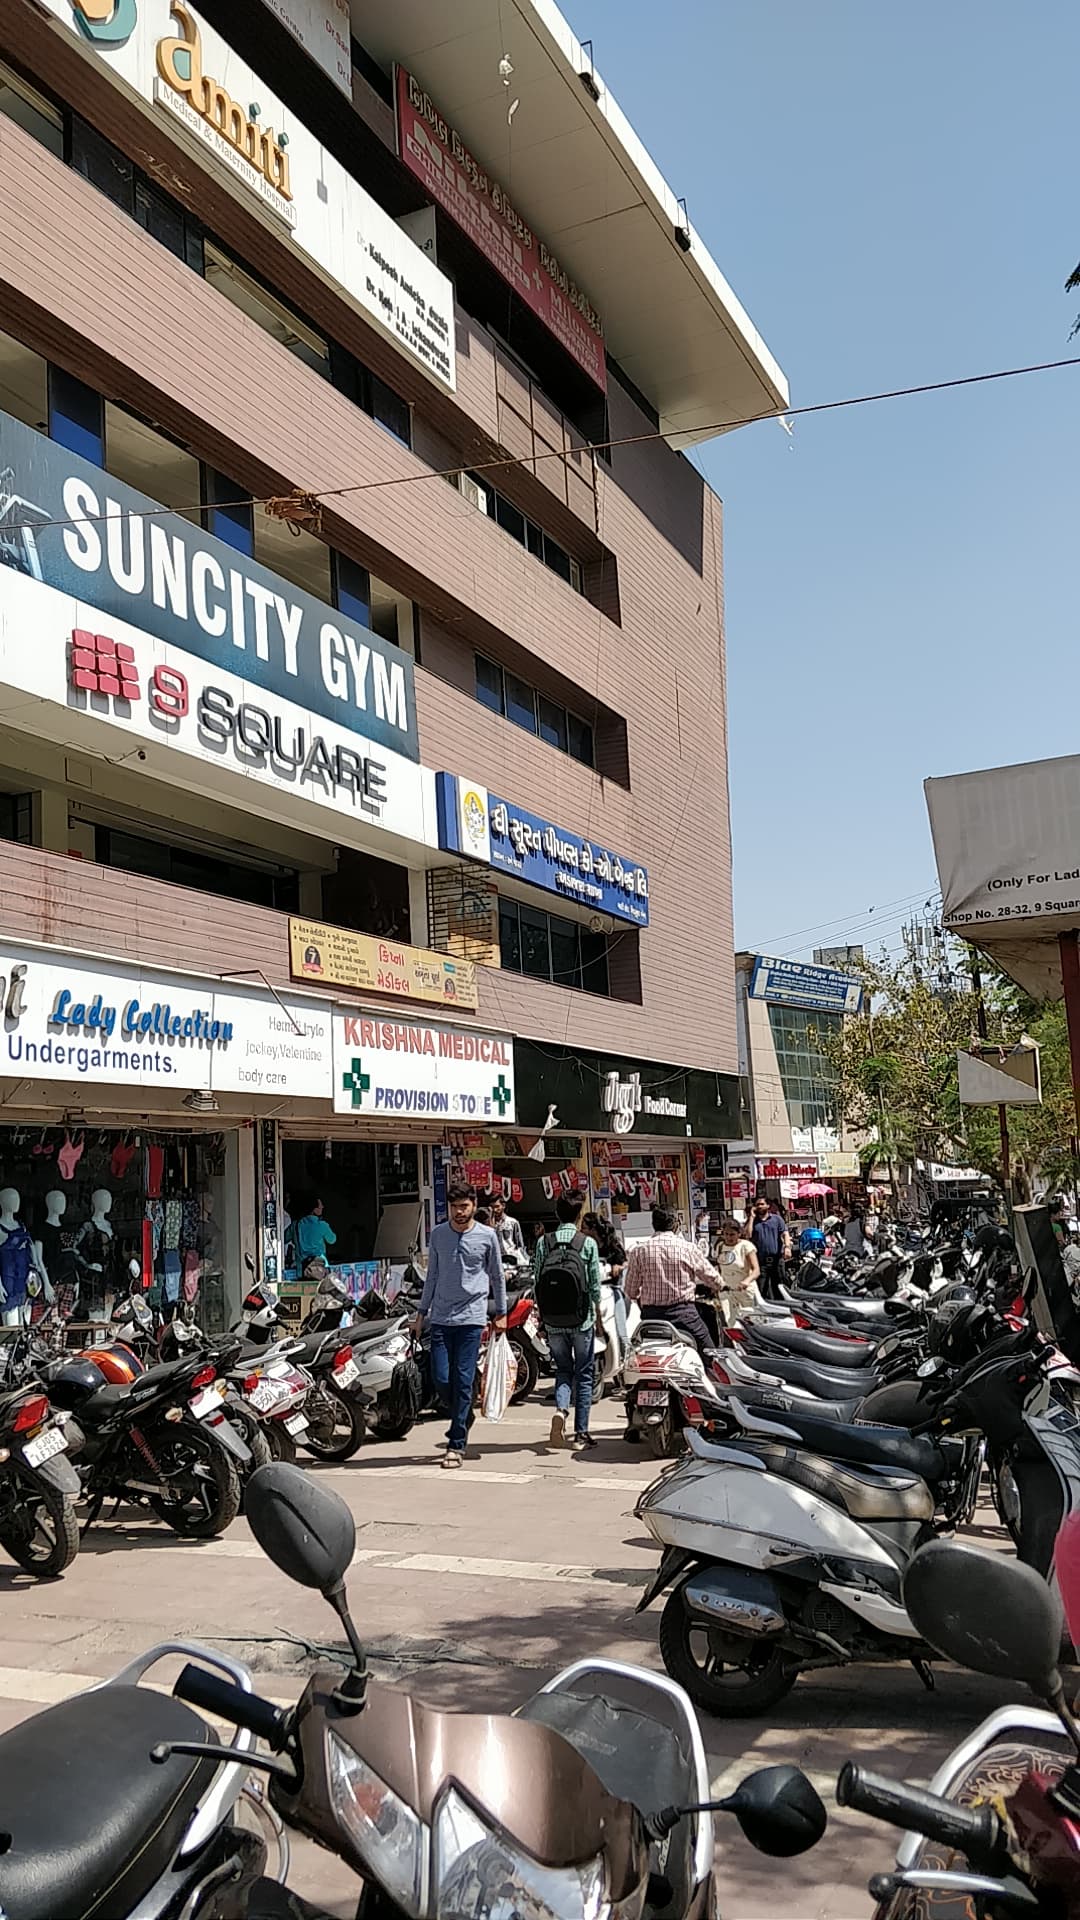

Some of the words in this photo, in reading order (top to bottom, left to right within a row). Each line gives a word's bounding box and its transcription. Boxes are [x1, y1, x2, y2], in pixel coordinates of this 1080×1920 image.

[163, 84, 202, 135] Medical
[203, 127, 214, 141] &
[214, 136, 258, 188] Maternity
[259, 179, 294, 221] Hospital
[414, 120, 523, 266] Nikhil
[366, 275, 377, 298] Dr.
[62, 476, 305, 677] SUNCITY
[319, 622, 409, 733] GYM
[153, 664, 189, 717] 9
[202, 685, 388, 802] SQUARE
[987, 878, 1024, 893] (Only
[1027, 874, 1051, 885] For
[943, 914, 972, 924] Shop
[975, 909, 995, 919] No.
[998, 904, 1032, 917] 28-32,
[1034, 902, 1042, 912] 9
[377, 968, 410, 993] મેડીકલ
[761, 957, 803, 974] Blue
[803, 967, 828, 980] Ridge
[54, 989, 116, 1036] Lady
[126, 999, 233, 1042] Collection
[344, 1016, 436, 1057] KRISHNA
[438, 1031, 510, 1066] MEDICAL
[8, 1034, 178, 1074] Undergarments.
[238, 1067, 264, 1086] body
[266, 1072, 287, 1085] care
[375, 1087, 449, 1112] PROVISION
[35, 1433, 57, 1450] GJ05
